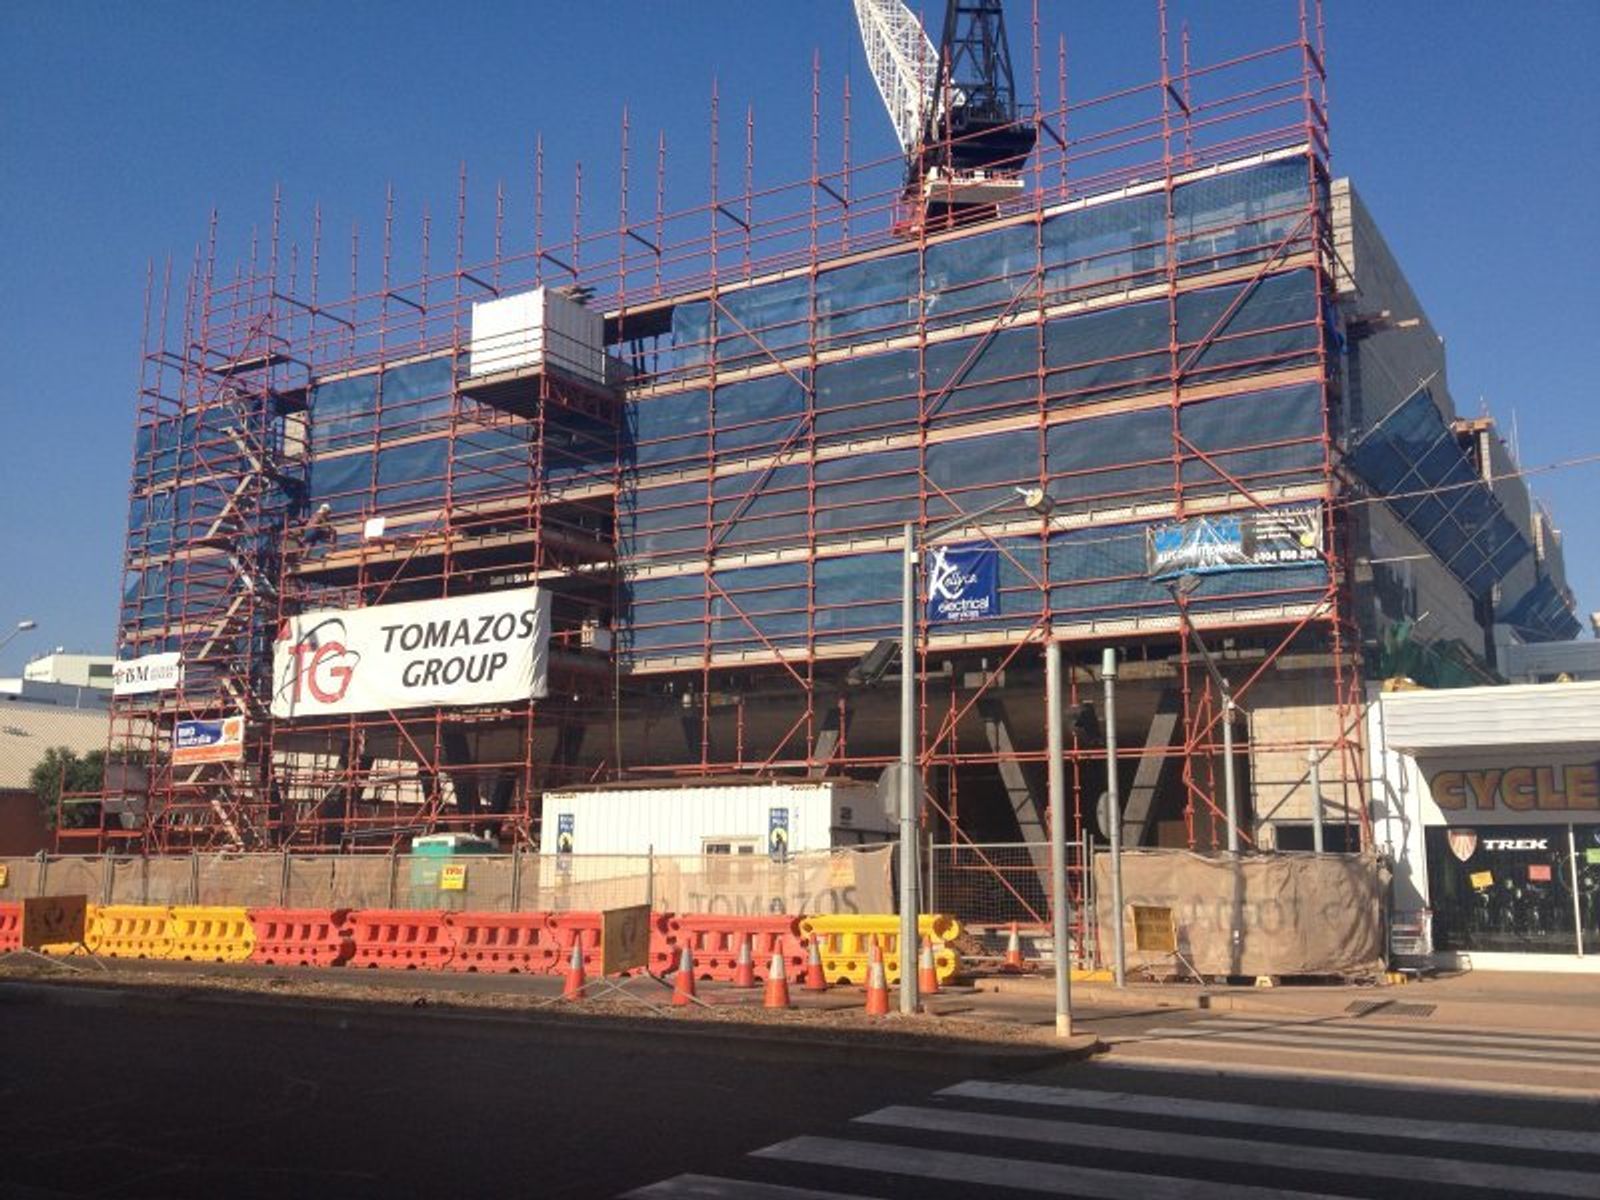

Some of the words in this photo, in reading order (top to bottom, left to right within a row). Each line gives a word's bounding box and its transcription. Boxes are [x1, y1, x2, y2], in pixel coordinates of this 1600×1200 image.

[381, 609, 539, 653] TOMAZOS
[402, 652, 507, 688] GROUP
[1431, 765, 1600, 811] CYCLE
[1483, 839, 1548, 850] TREK
